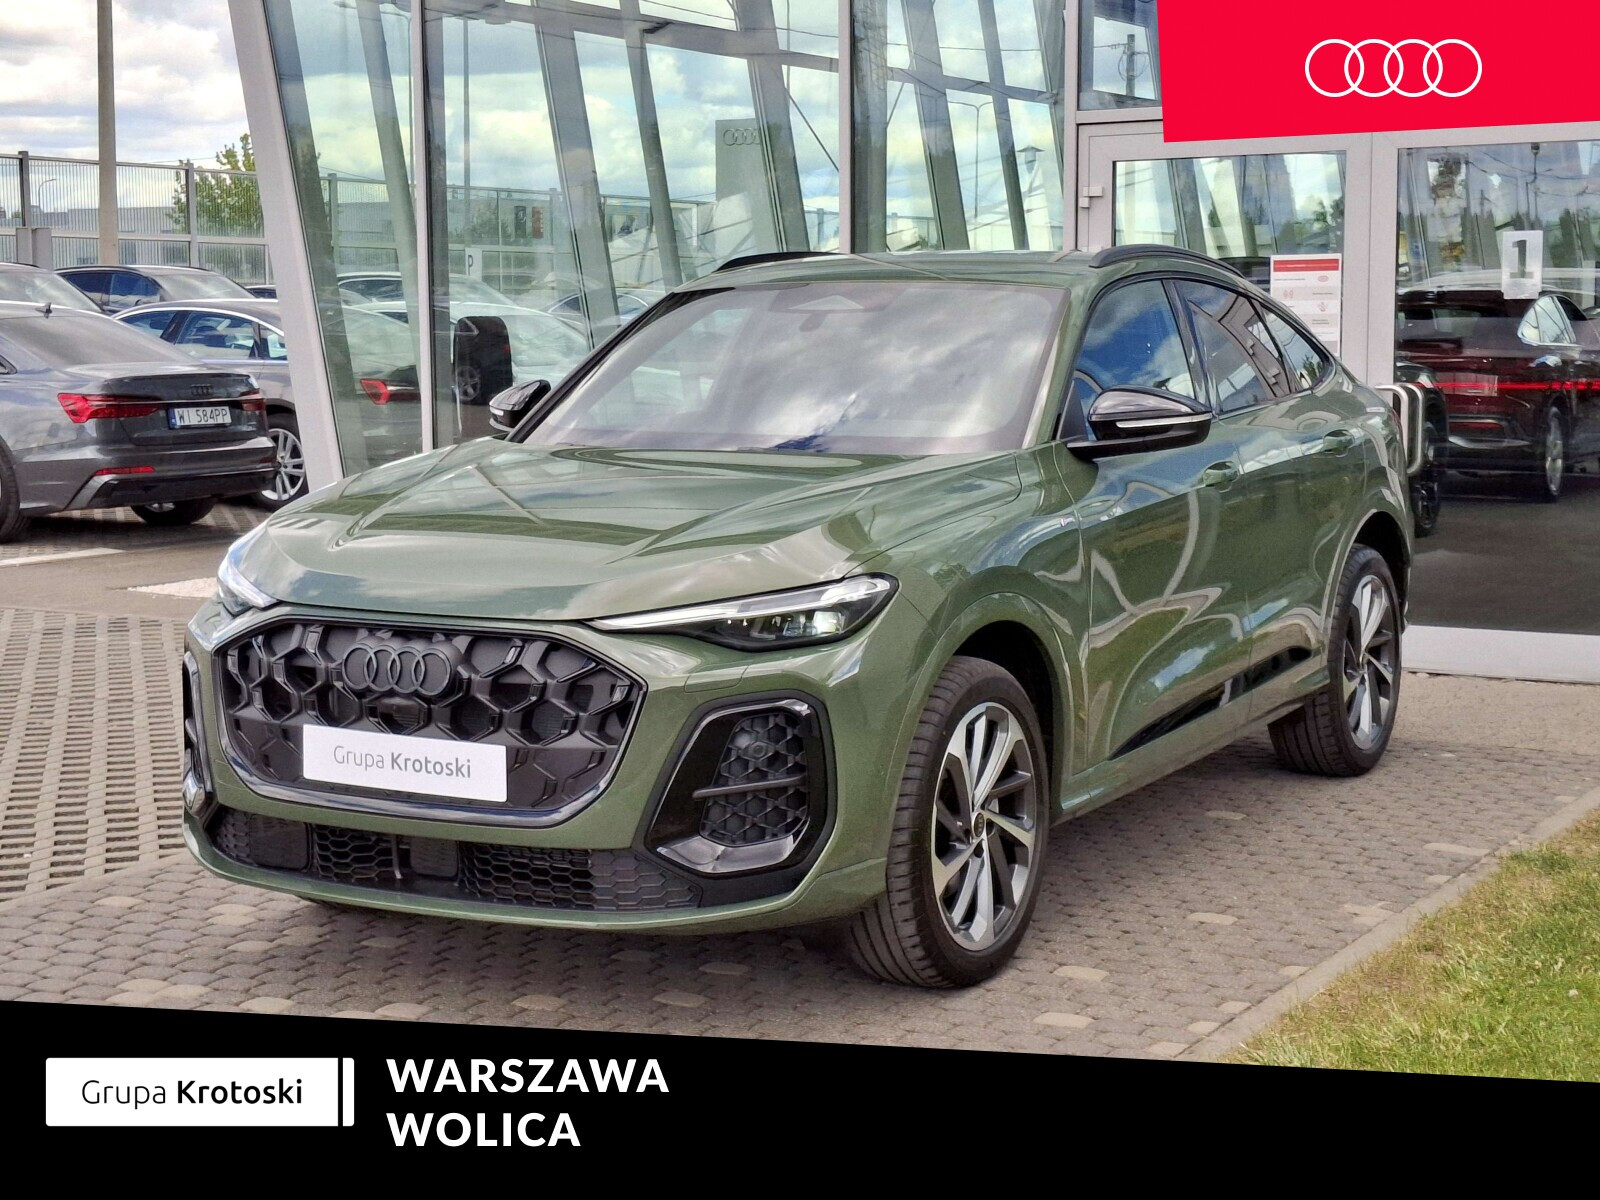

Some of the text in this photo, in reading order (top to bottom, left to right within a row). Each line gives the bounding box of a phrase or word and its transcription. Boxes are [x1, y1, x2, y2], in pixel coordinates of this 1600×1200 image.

[1509, 239, 1535, 279] 1
[177, 408, 228, 424] WI 584PP
[333, 745, 471, 778] Grupa Krotoski
